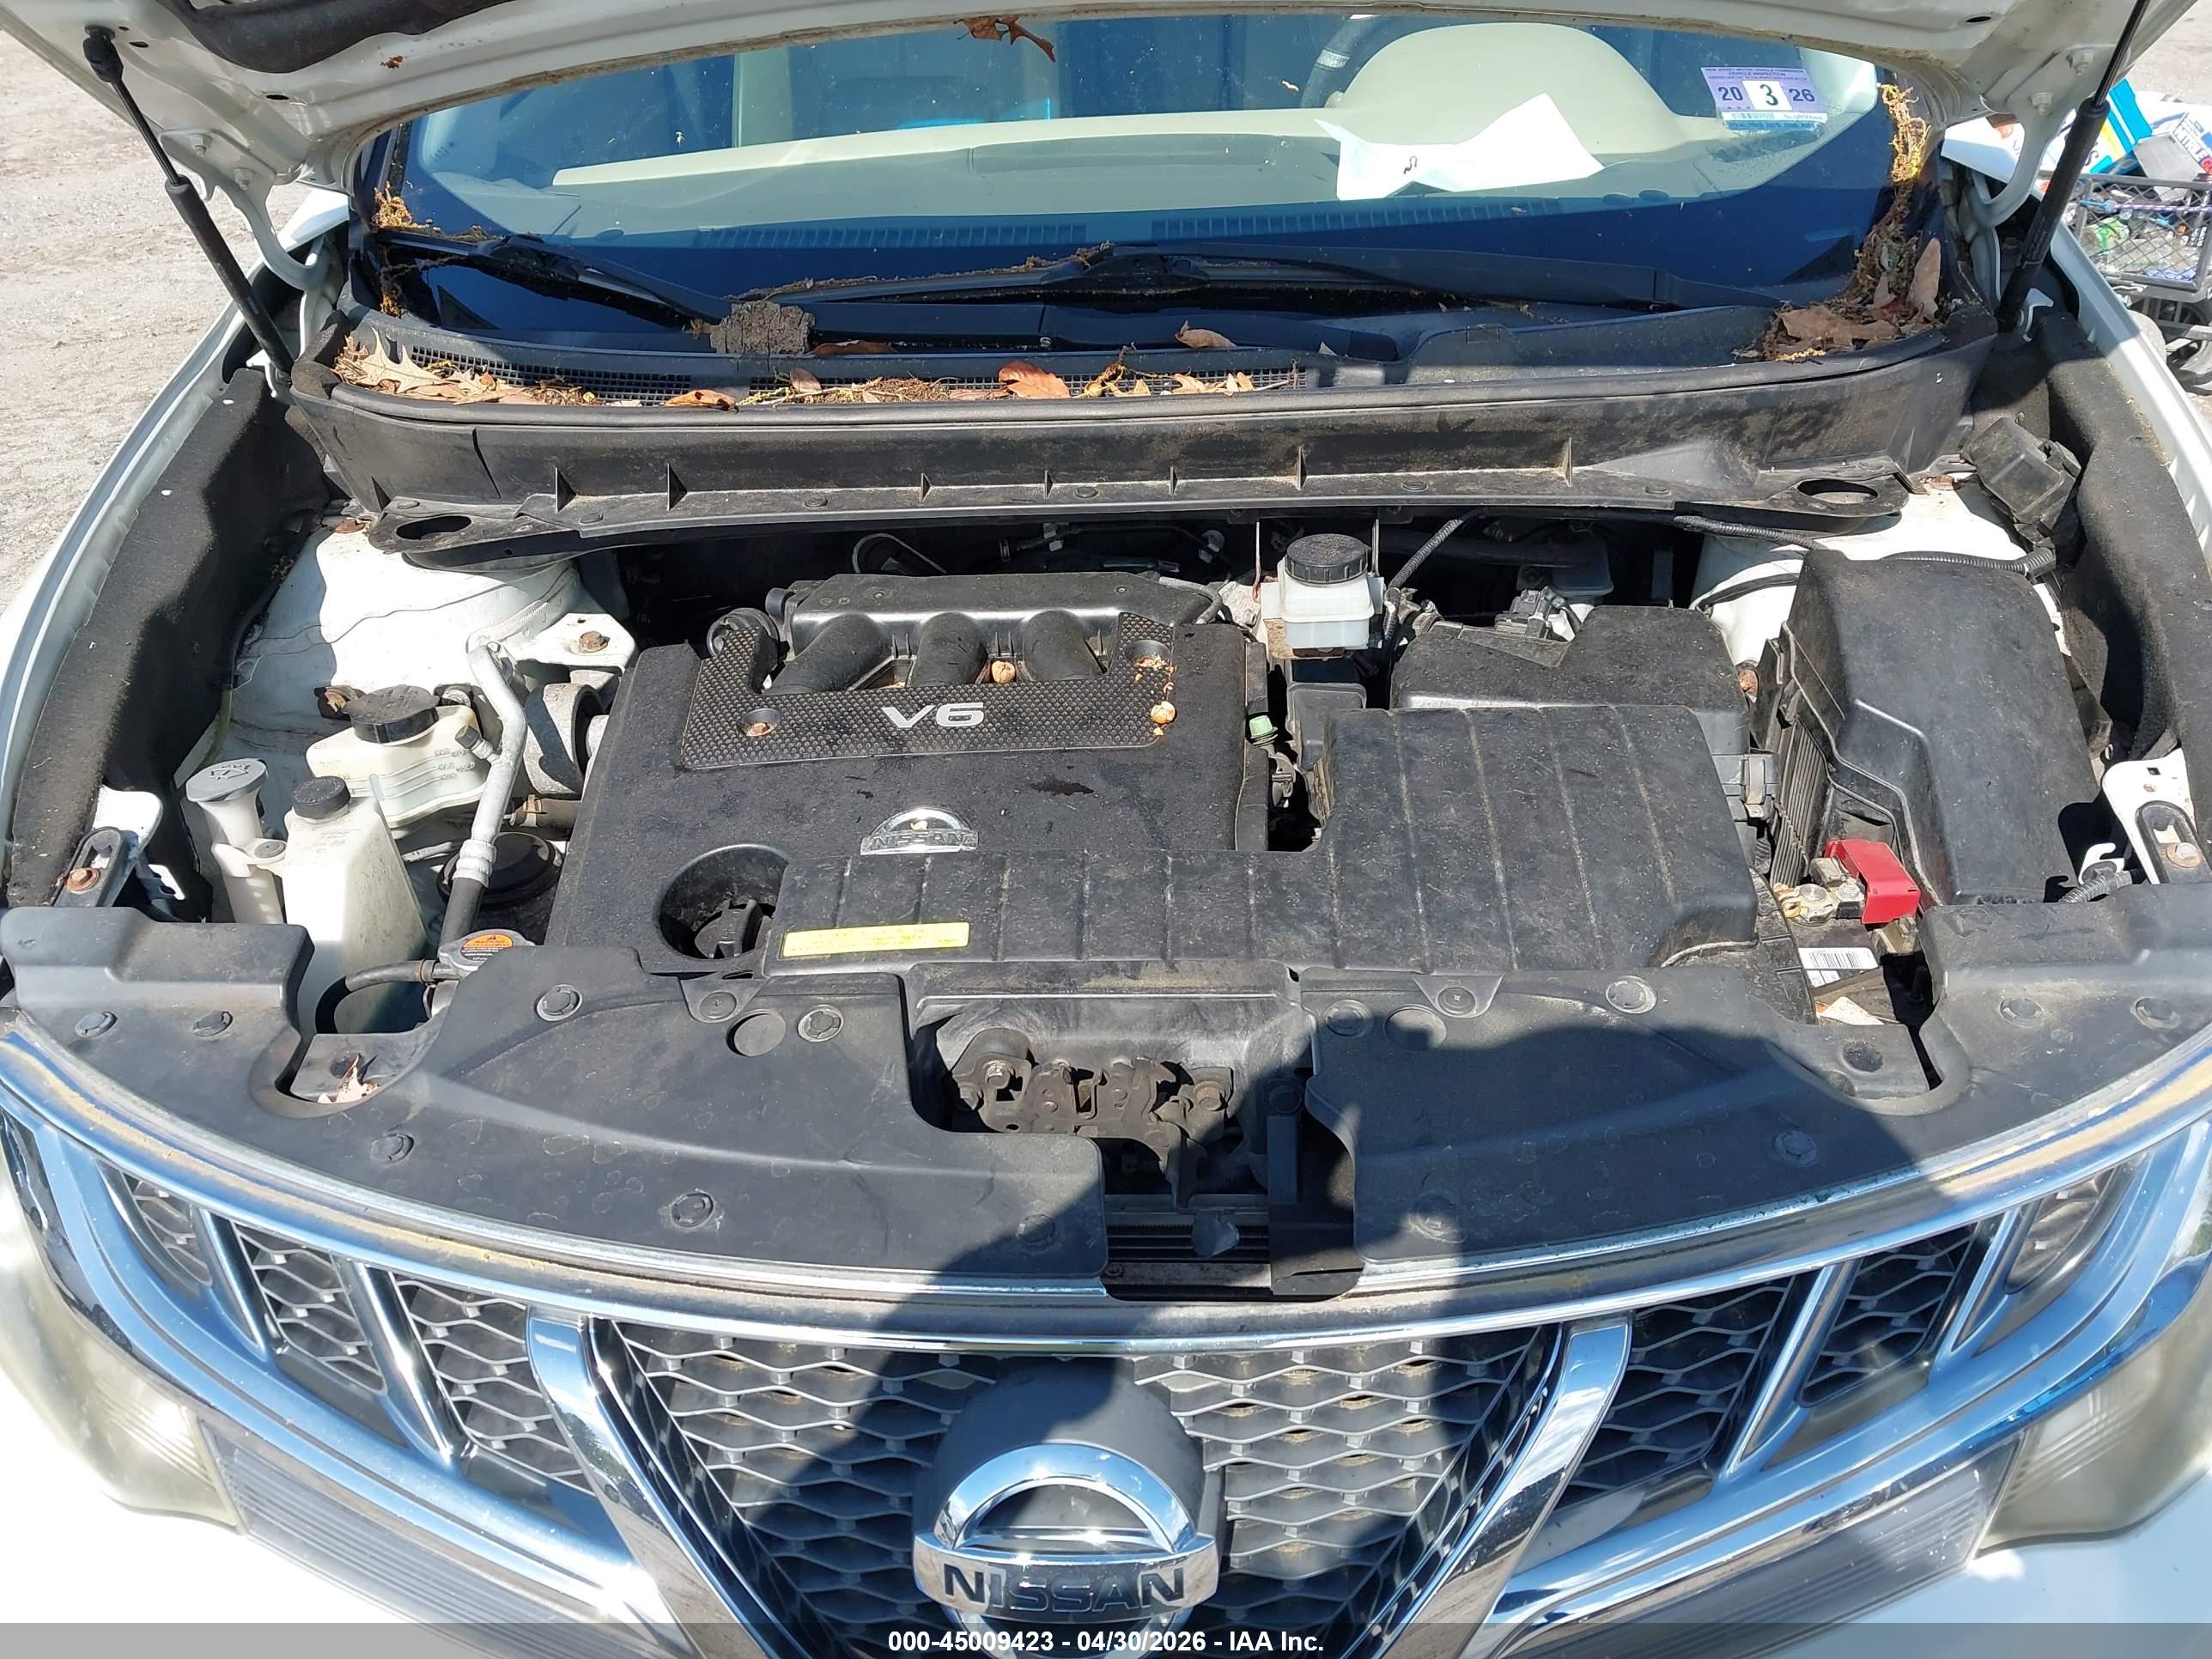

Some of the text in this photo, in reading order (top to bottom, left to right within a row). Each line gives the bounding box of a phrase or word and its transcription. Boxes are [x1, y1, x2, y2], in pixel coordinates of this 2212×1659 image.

[1718, 83, 1815, 106] 20 3 26
[880, 702, 984, 728] V6
[872, 831, 963, 847] NISSAN
[943, 1563, 1186, 1613] NISSAN
